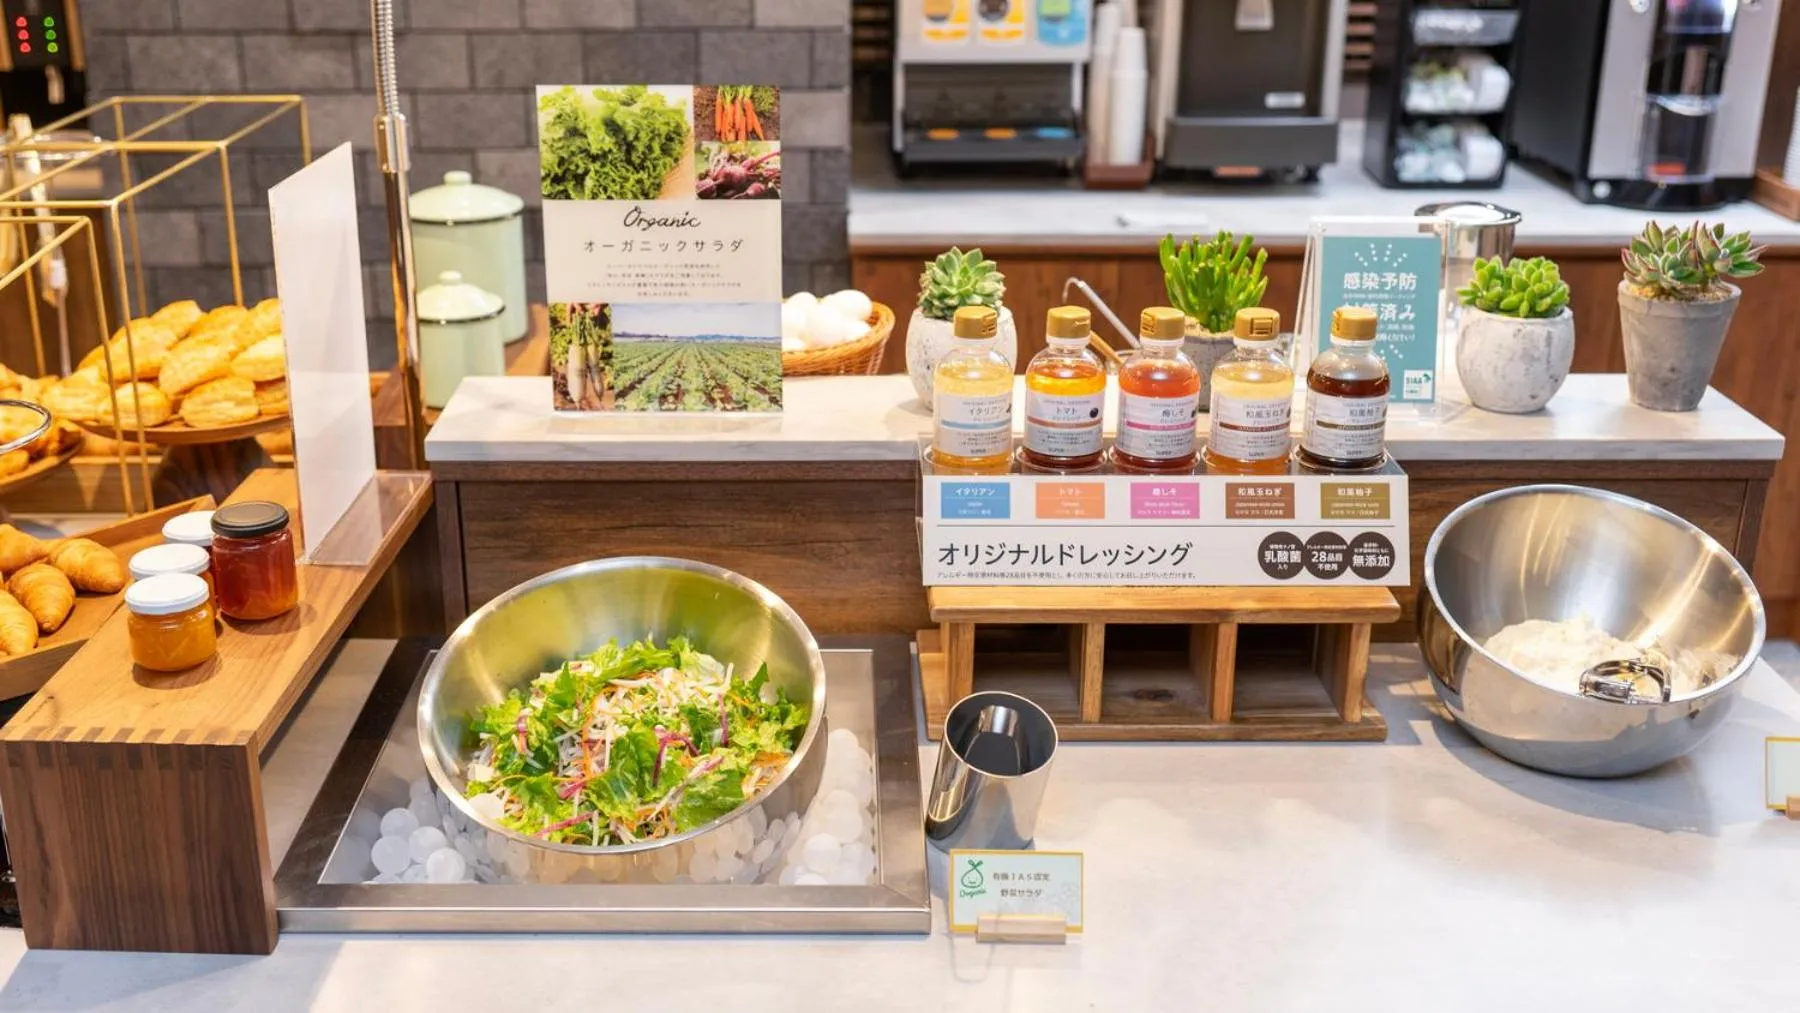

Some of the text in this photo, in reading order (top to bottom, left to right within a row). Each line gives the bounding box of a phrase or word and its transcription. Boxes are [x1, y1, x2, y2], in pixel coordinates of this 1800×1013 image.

[623, 206, 701, 231] Organic
[584, 239, 744, 252] オーガニックサラダ
[1343, 272, 1418, 291] 感染予防
[1056, 407, 1078, 415] トマト
[955, 487, 995, 496] イタリアン
[1060, 488, 1083, 496] トマト
[1238, 487, 1282, 497] 和風玉ねぎ
[938, 543, 1194, 567] オリジナルドレッシング
[1264, 550, 1301, 564] 乳酸菌
[1311, 551, 1343, 563] 28品目
[1352, 554, 1390, 568] 無添加
[1318, 563, 1338, 571] 不使用
[1000, 888, 1042, 897] 野菜サラダ
